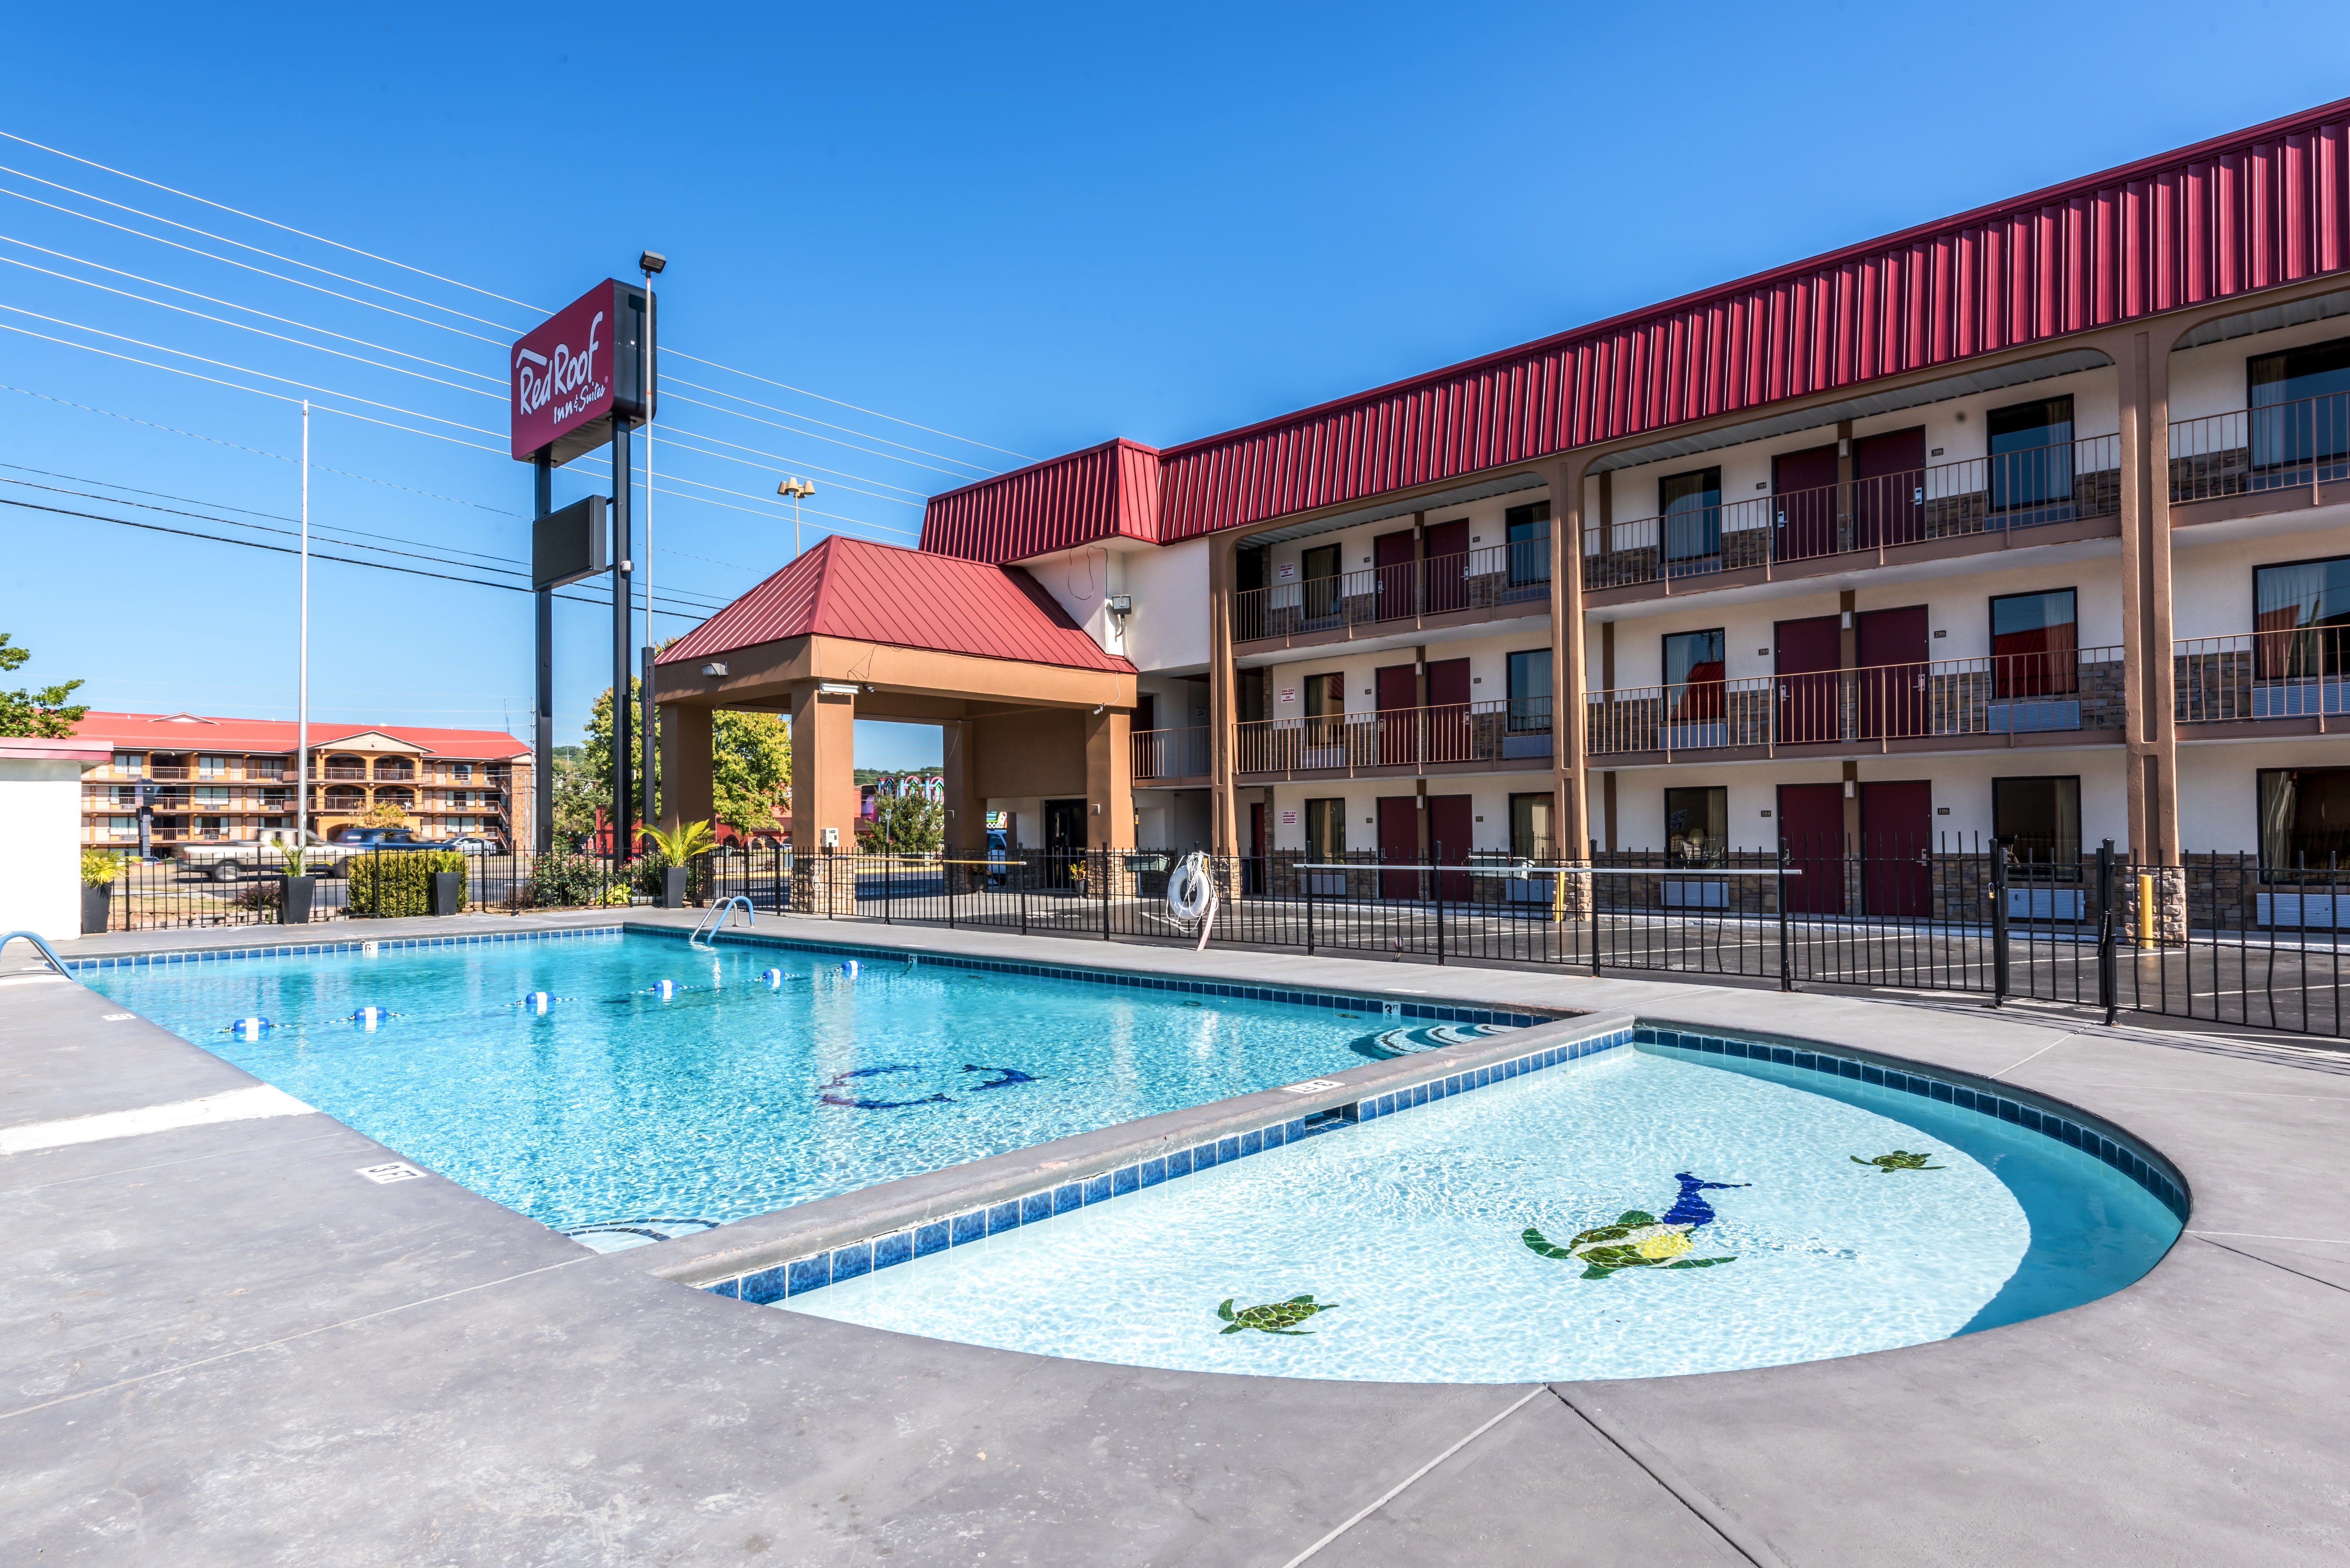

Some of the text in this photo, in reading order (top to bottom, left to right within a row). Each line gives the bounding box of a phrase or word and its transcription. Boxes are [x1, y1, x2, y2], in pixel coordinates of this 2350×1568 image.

[520, 311, 603, 415] Red Roof
[554, 381, 605, 425] Inn & Suites
[1384, 1004, 1392, 1014] 3
[367, 1165, 421, 1181] 3 FT
